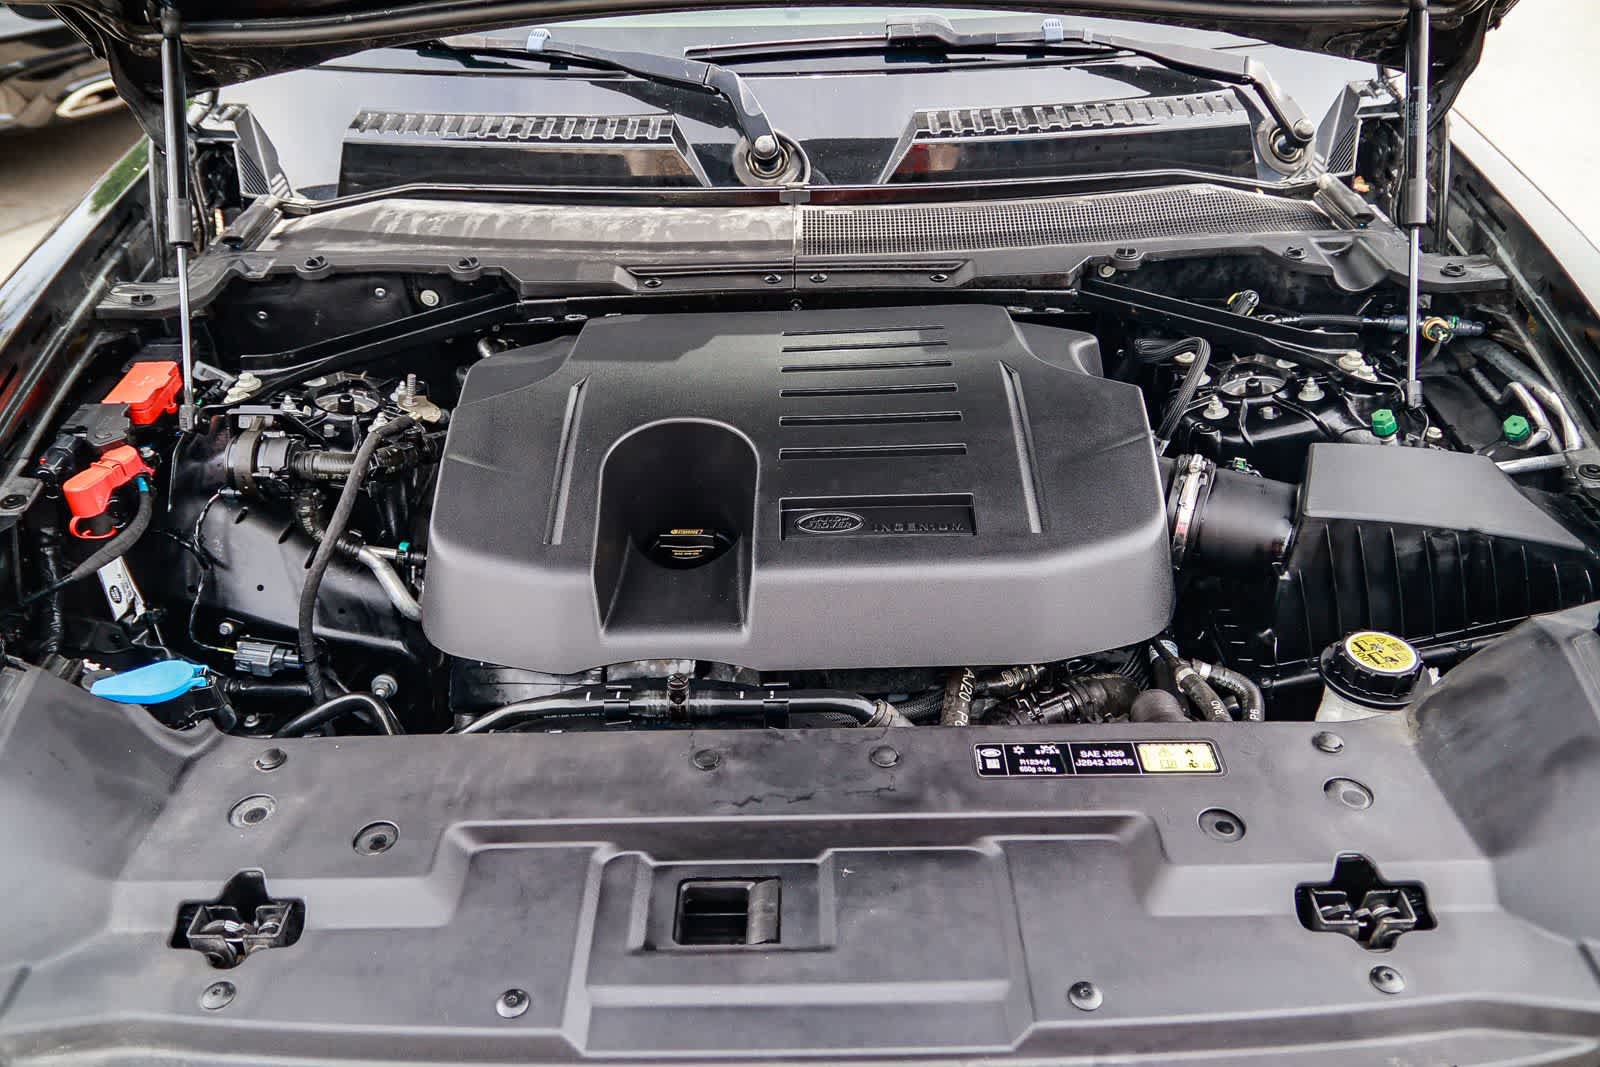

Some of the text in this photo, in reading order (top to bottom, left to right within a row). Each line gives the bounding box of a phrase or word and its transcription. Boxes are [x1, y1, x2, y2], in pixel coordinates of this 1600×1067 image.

[873, 520, 965, 533] INGENIUM
[1079, 750, 1125, 759] SAE J639
